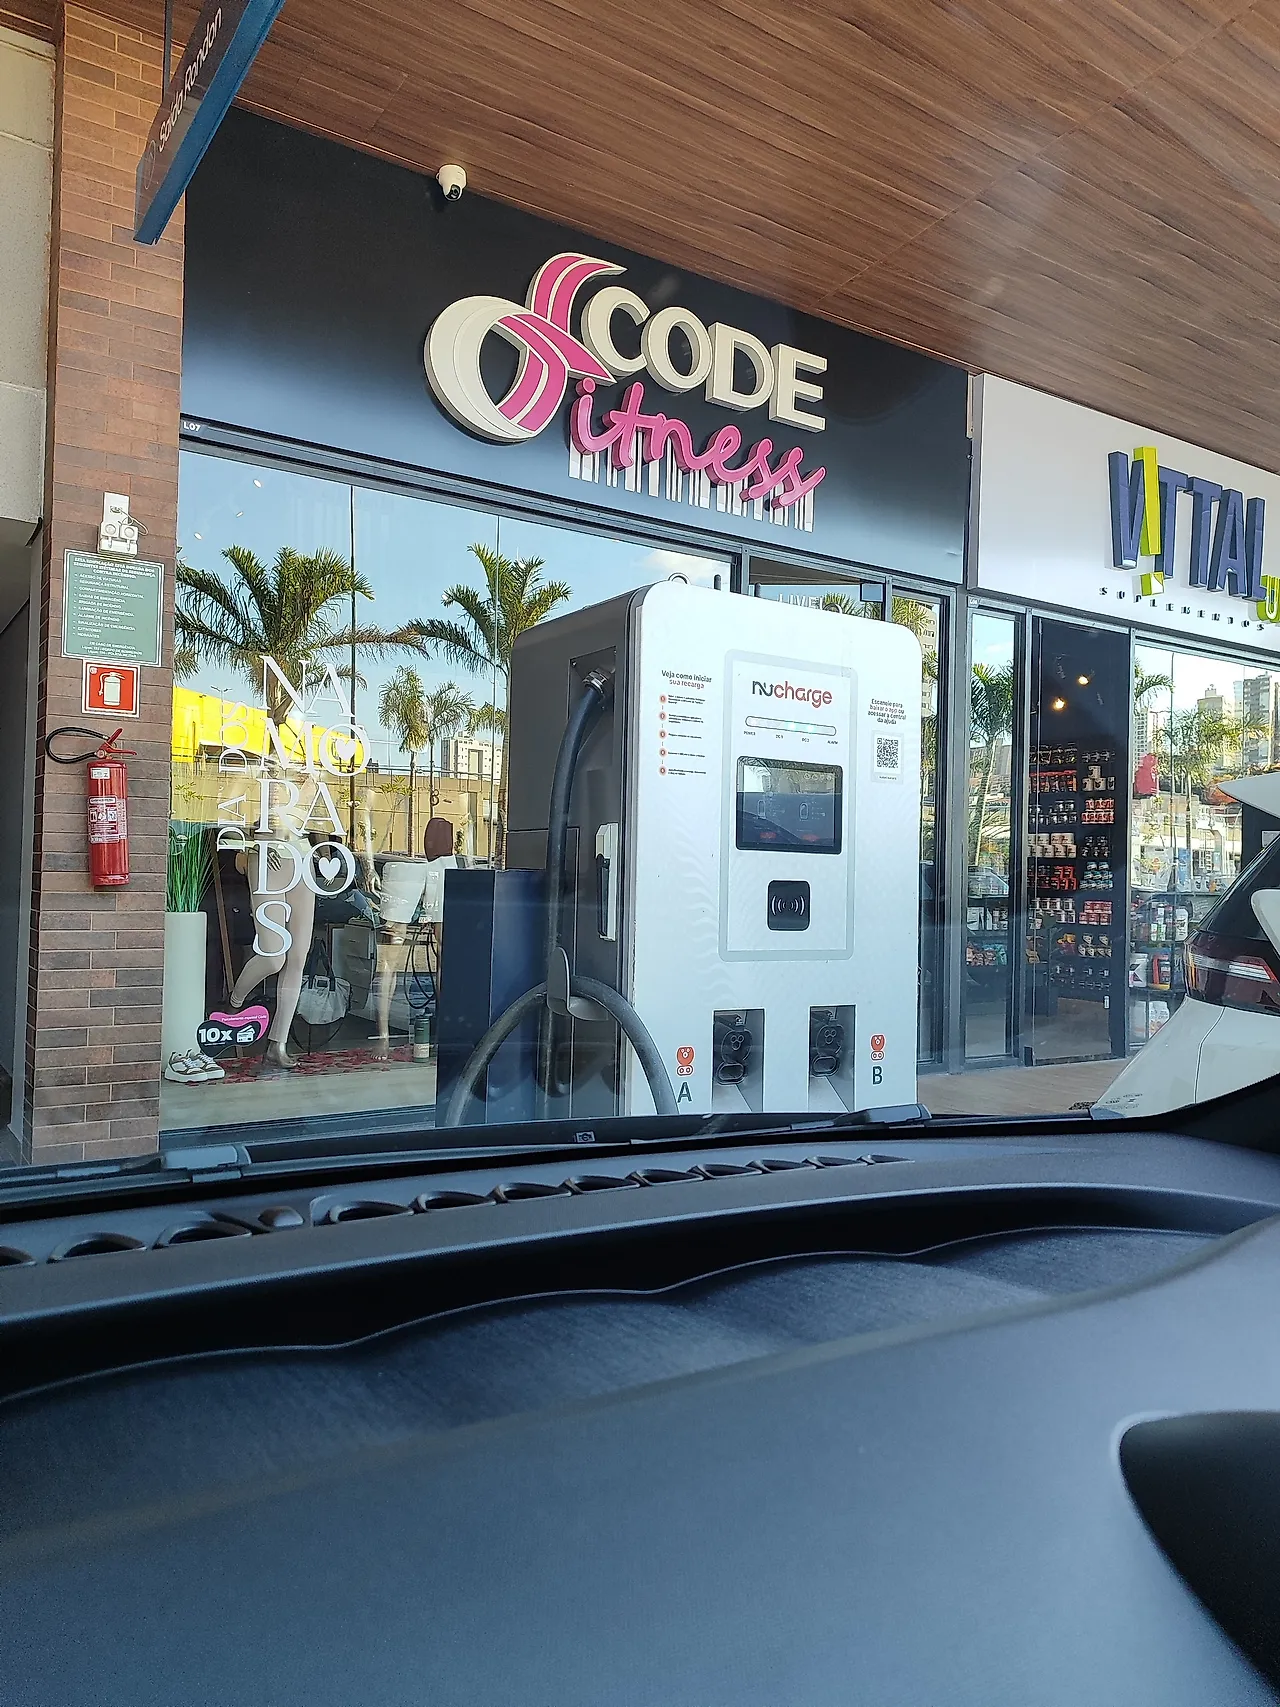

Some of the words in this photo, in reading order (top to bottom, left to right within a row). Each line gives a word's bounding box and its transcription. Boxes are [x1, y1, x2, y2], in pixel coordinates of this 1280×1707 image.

[184, 8, 222, 100] Rondon
[581, 286, 828, 433] CODE
[183, 421, 200, 431] L07
[661, 670, 675, 679] Veja
[676, 673, 692, 681] como
[694, 674, 712, 683] iniciar
[681, 680, 705, 689] recarga
[752, 681, 832, 708] nucharge
[219, 700, 249, 773] DOS
[216, 794, 248, 852] DIA
[199, 1027, 232, 1043] 10x
[873, 1066, 882, 1084] B
[677, 1082, 692, 1103] A
